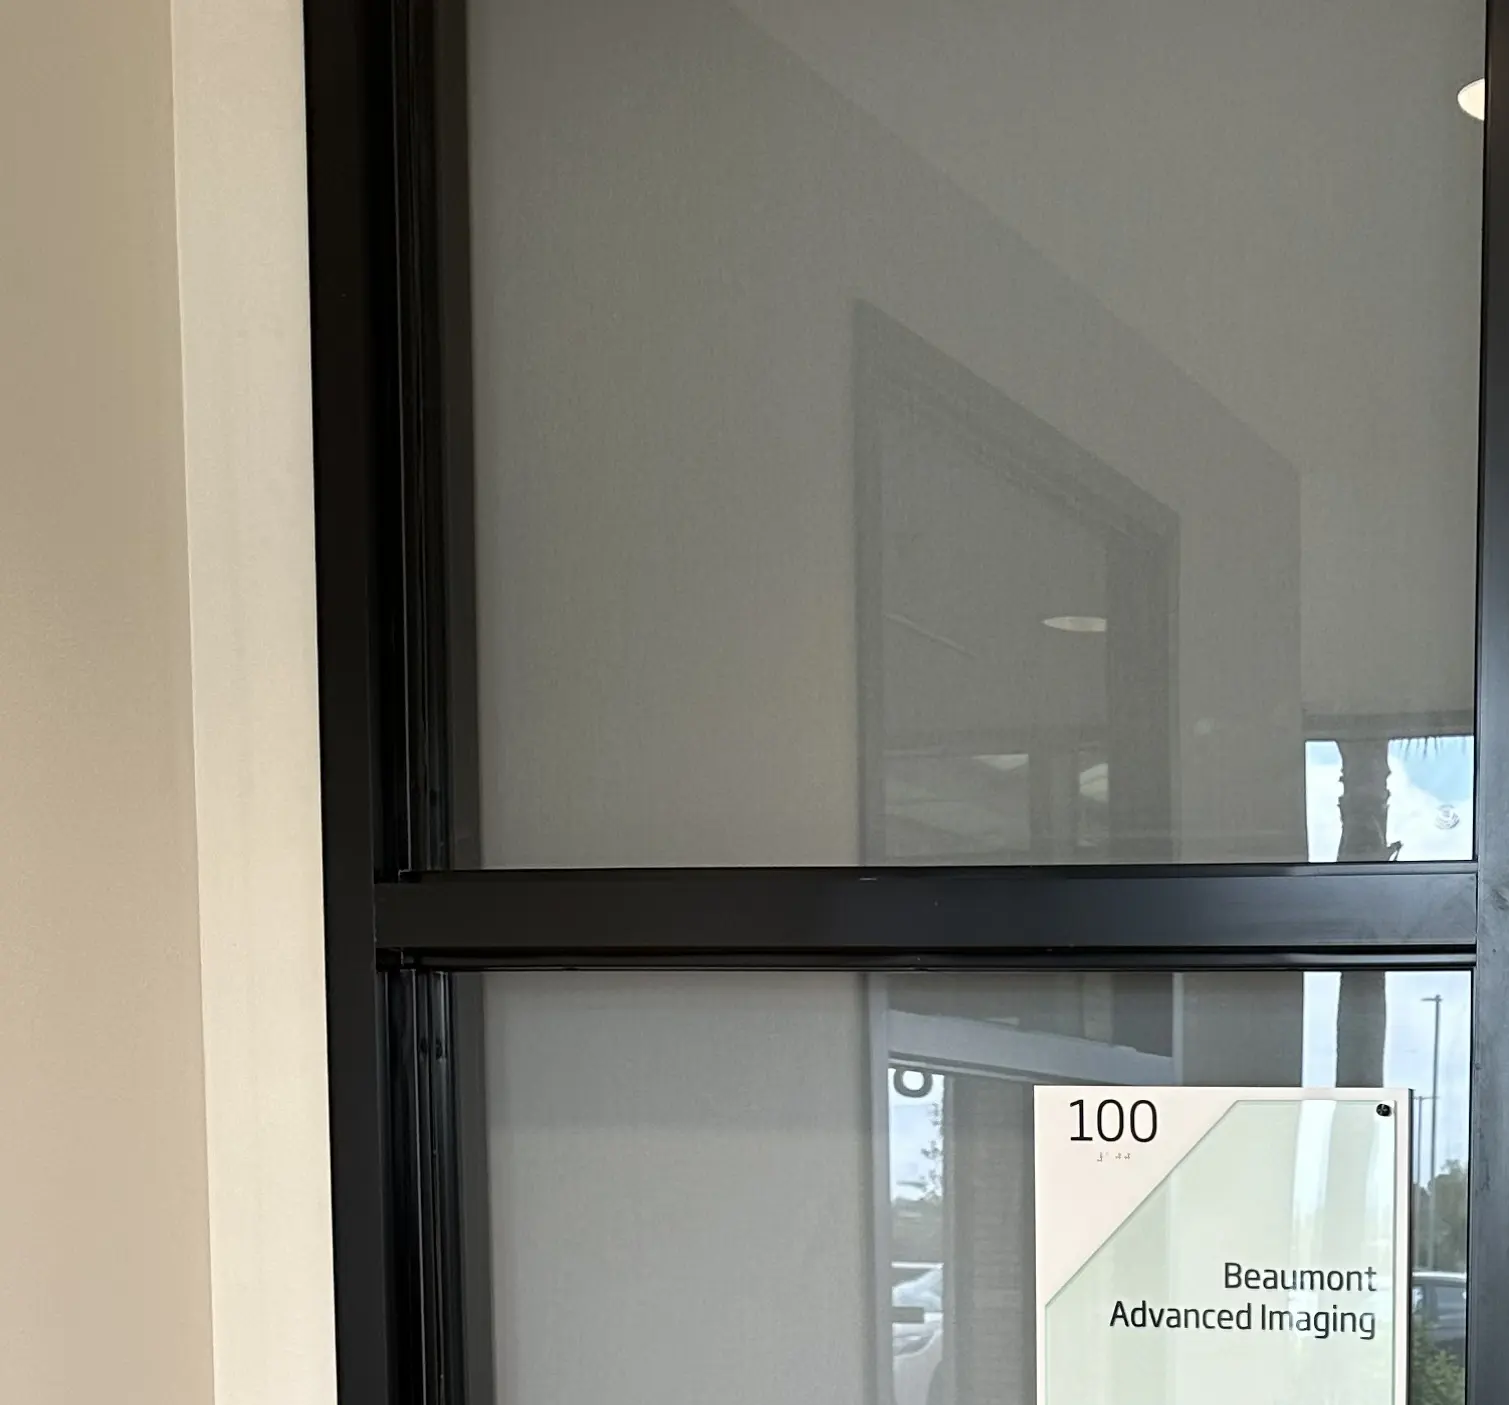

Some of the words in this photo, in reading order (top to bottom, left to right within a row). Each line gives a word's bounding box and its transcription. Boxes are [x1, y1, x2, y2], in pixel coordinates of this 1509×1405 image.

[1070, 1099, 1157, 1142] 100
[1224, 1262, 1377, 1292] Beaumont
[1109, 1301, 1251, 1330] Advanced
[1261, 1304, 1376, 1340] Imaging
